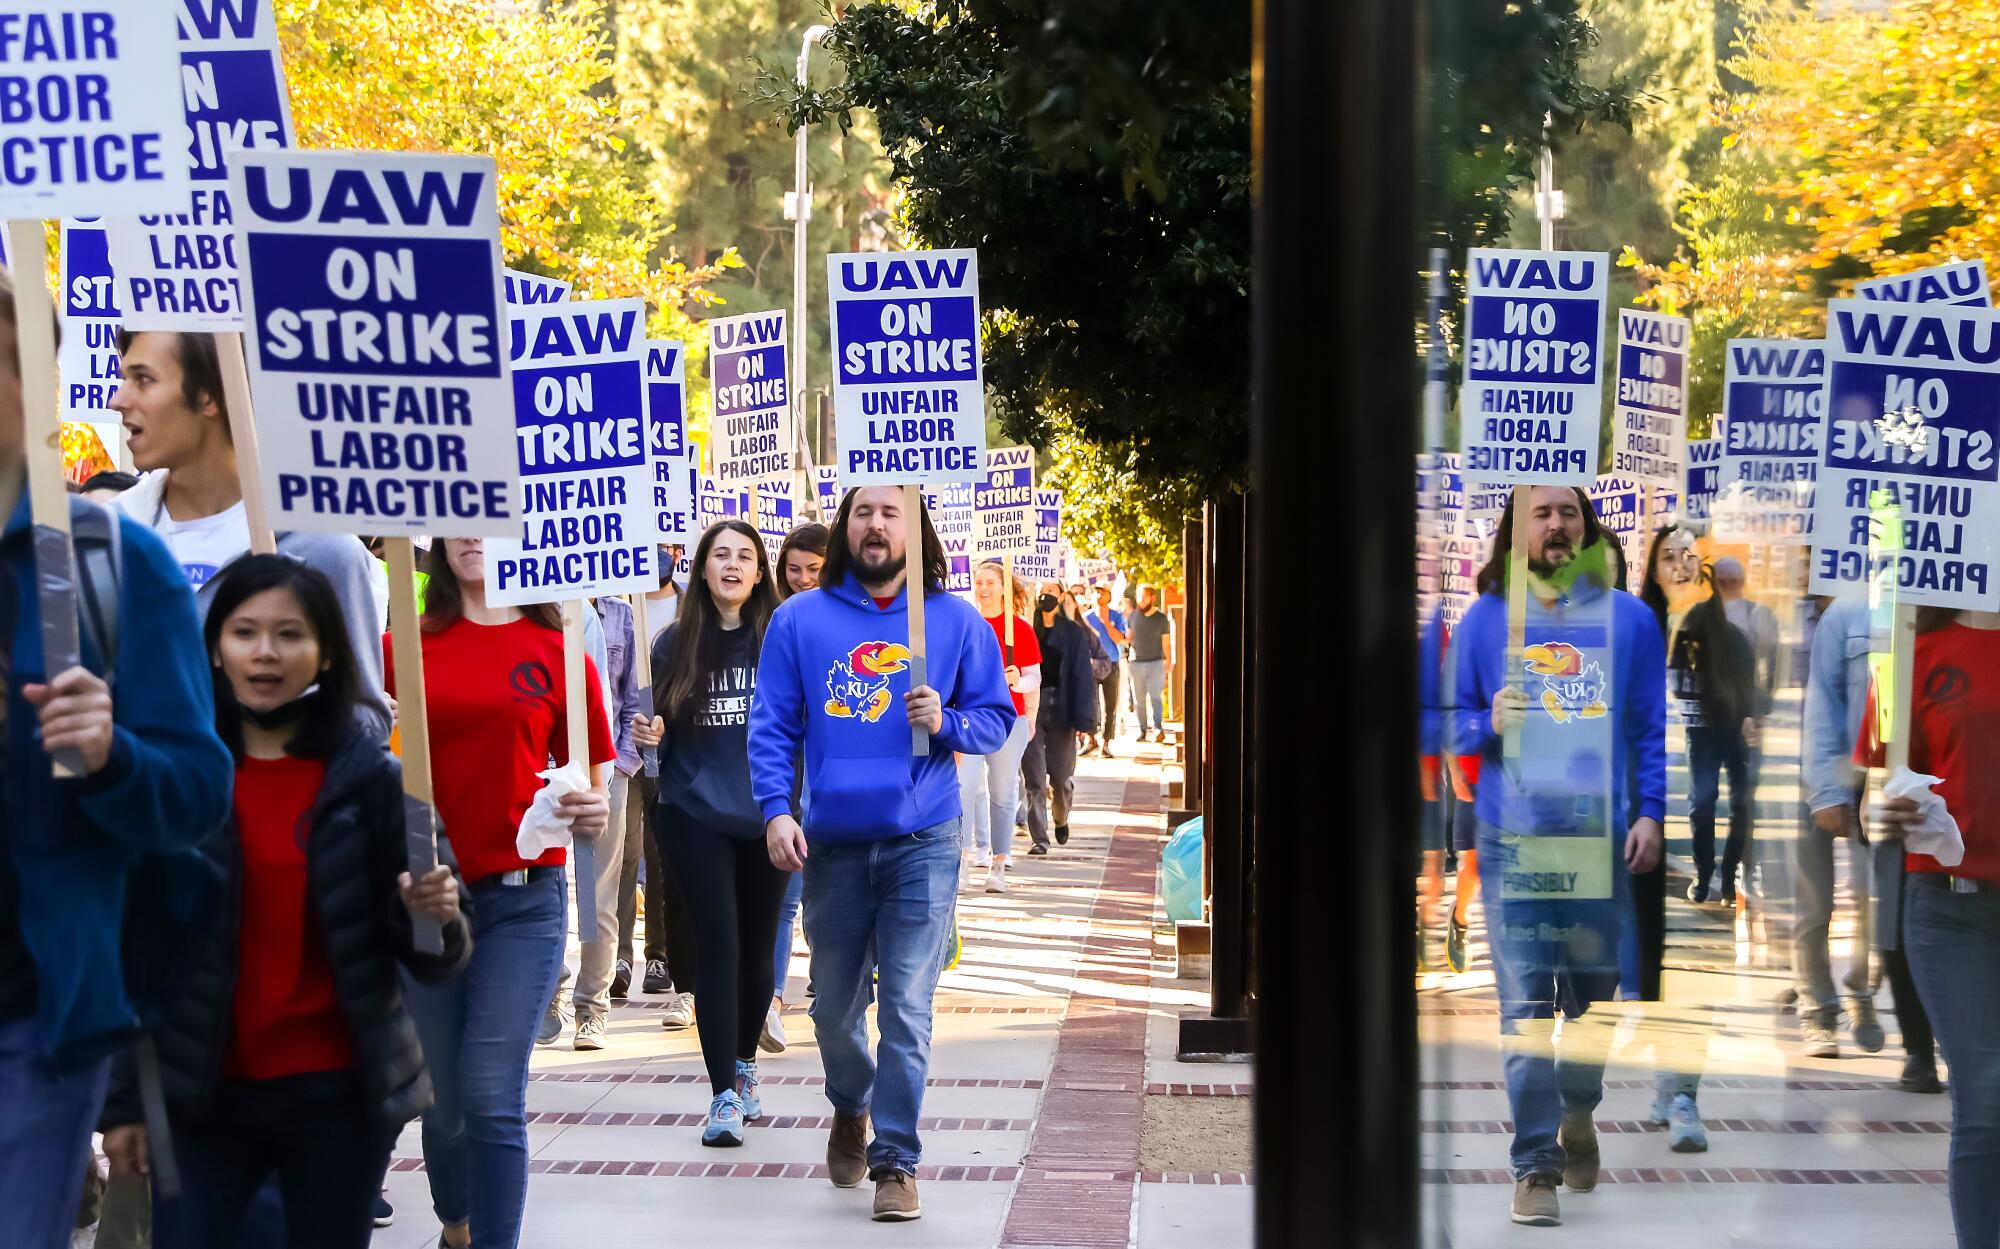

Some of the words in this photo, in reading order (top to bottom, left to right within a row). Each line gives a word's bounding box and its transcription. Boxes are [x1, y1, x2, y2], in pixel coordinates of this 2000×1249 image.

[0, 12, 118, 62] FAIR
[2, 74, 112, 123] BOR
[0, 132, 164, 187] CTICE
[243, 165, 485, 227] UAW
[150, 234, 239, 270] LABO
[326, 247, 416, 302] ON
[841, 258, 969, 292] UAW
[129, 277, 242, 313] PRACT
[714, 317, 783, 349] UAW
[880, 302, 932, 336] ON
[265, 307, 492, 366] STRIKE
[737, 352, 764, 380] ON
[844, 338, 973, 376] STRIKE
[297, 383, 473, 427] UNFAIR
[534, 372, 594, 417] ON
[717, 379, 785, 412] STRIKE
[861, 389, 959, 415] UNFAIR
[727, 411, 778, 437] UNFAIR
[868, 418, 955, 444] LABOR
[311, 429, 468, 473] LABOR
[517, 418, 641, 467] TRIKE
[730, 434, 777, 458] LABOR
[720, 453, 789, 480] PRACTICE
[849, 446, 978, 473] PRACTICE
[757, 481, 790, 495] AW
[992, 470, 1014, 488] ON
[278, 474, 511, 520] PRACTICE
[703, 497, 724, 513] ON
[976, 486, 1031, 507] STRIKE
[522, 512, 623, 551] LABOR
[934, 510, 972, 522] NFAIR
[983, 510, 1024, 525] UNFAIR
[986, 524, 1022, 537] LABOR
[977, 536, 1031, 552] PRACTICE
[1014, 555, 1048, 566] LABOR
[497, 546, 650, 591] PRACTICE
[848, 680, 868, 697] KU
